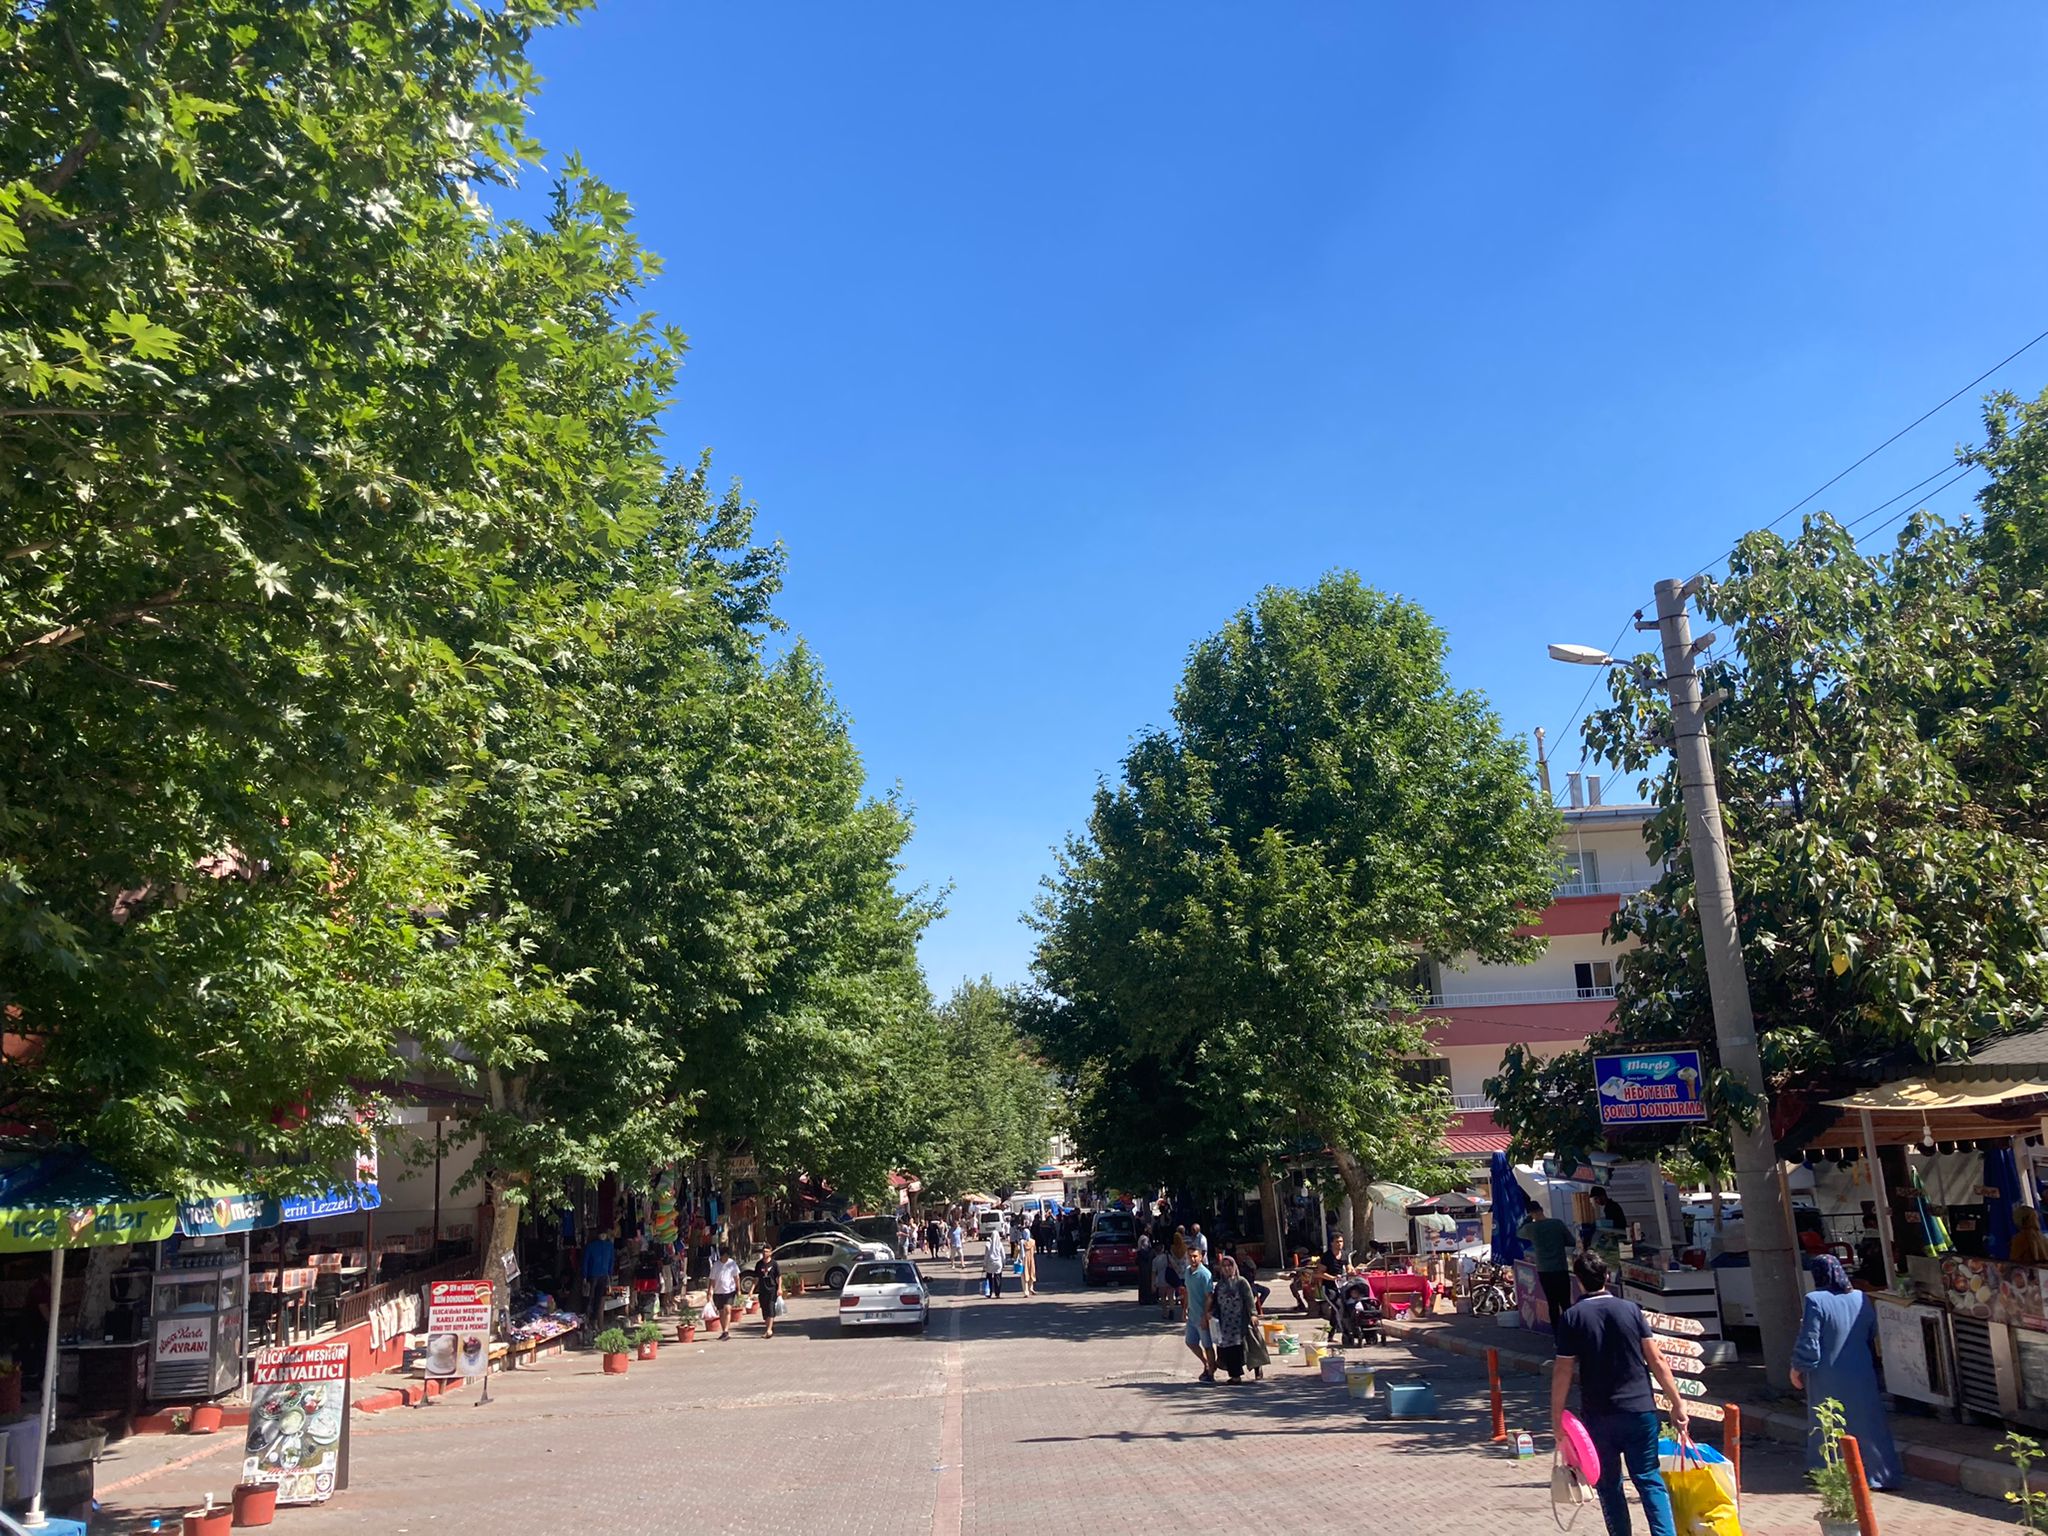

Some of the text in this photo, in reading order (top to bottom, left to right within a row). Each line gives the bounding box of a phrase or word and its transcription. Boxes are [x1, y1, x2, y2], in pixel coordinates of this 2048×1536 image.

[1603, 1101, 1704, 1121] ŞOKLU DONDURMA
[231, 1200, 264, 1220] mar
[94, 1210, 148, 1233] mar
[257, 1363, 344, 1383] KAHVALTICI
